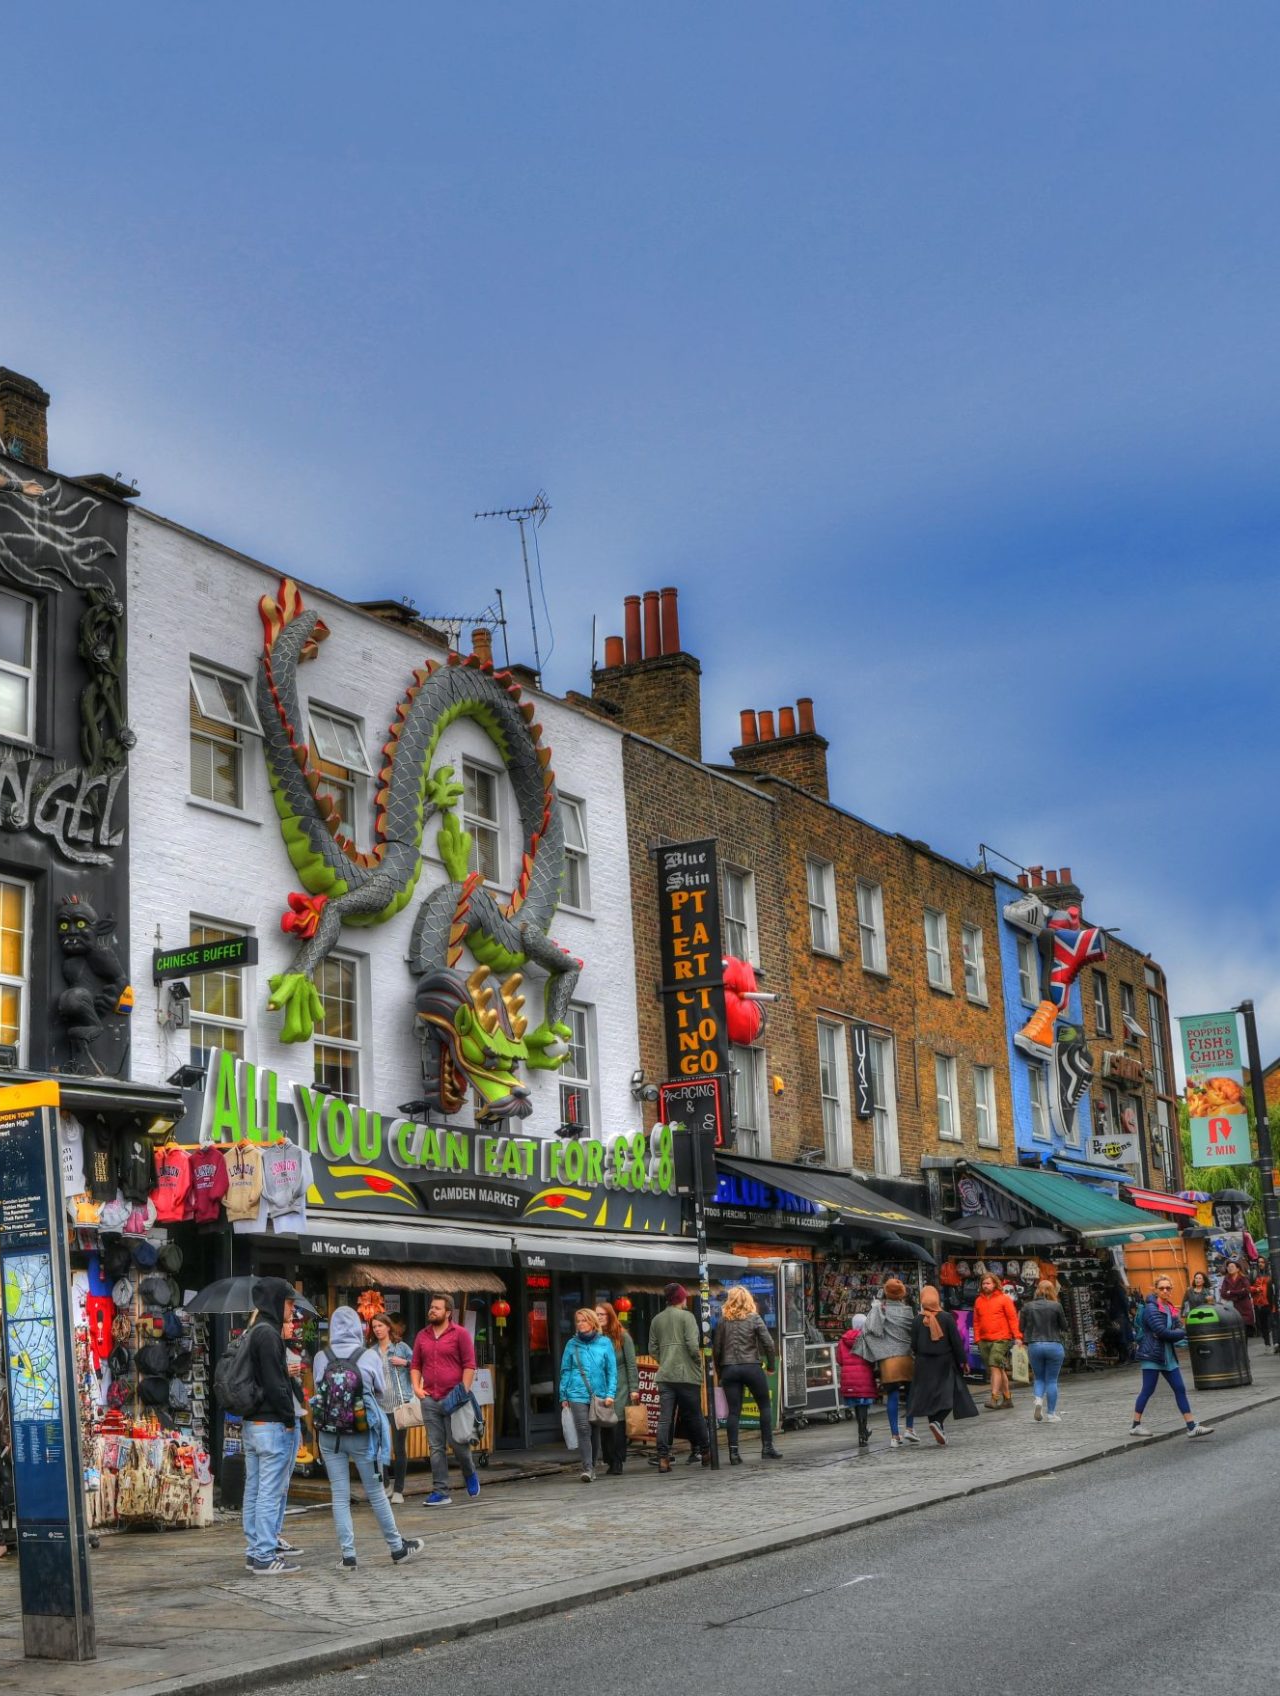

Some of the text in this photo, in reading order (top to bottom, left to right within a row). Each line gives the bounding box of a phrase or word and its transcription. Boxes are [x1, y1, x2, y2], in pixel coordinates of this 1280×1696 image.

[664, 851, 707, 870] Blue
[666, 871, 710, 892] Skin
[156, 943, 243, 971] CHINESE BUFFET
[690, 890, 719, 1074] TATTOO
[1187, 1024, 1232, 1038] POPPIE'S
[1188, 1036, 1223, 1051] FISH
[1190, 1048, 1234, 1063] CHIPS
[686, 1100, 695, 1113] &
[18, 1111, 35, 1119] TOWN
[204, 1047, 676, 1194] ALL YOU CAN EAT FOR £8.8
[16, 1119, 29, 1128] High
[1093, 1141, 1132, 1155] Martens
[1206, 1145, 1236, 1157] 2 MIN
[229, 1164, 255, 1178] LONDON
[272, 1160, 297, 1177] LONDON
[433, 1186, 520, 1208] CAMDEN MARKET
[716, 1173, 771, 1209] BLUE
[723, 1209, 747, 1220] PIERCING
[311, 1241, 370, 1256] All You Can Eat
[527, 1256, 546, 1267] Buffet
